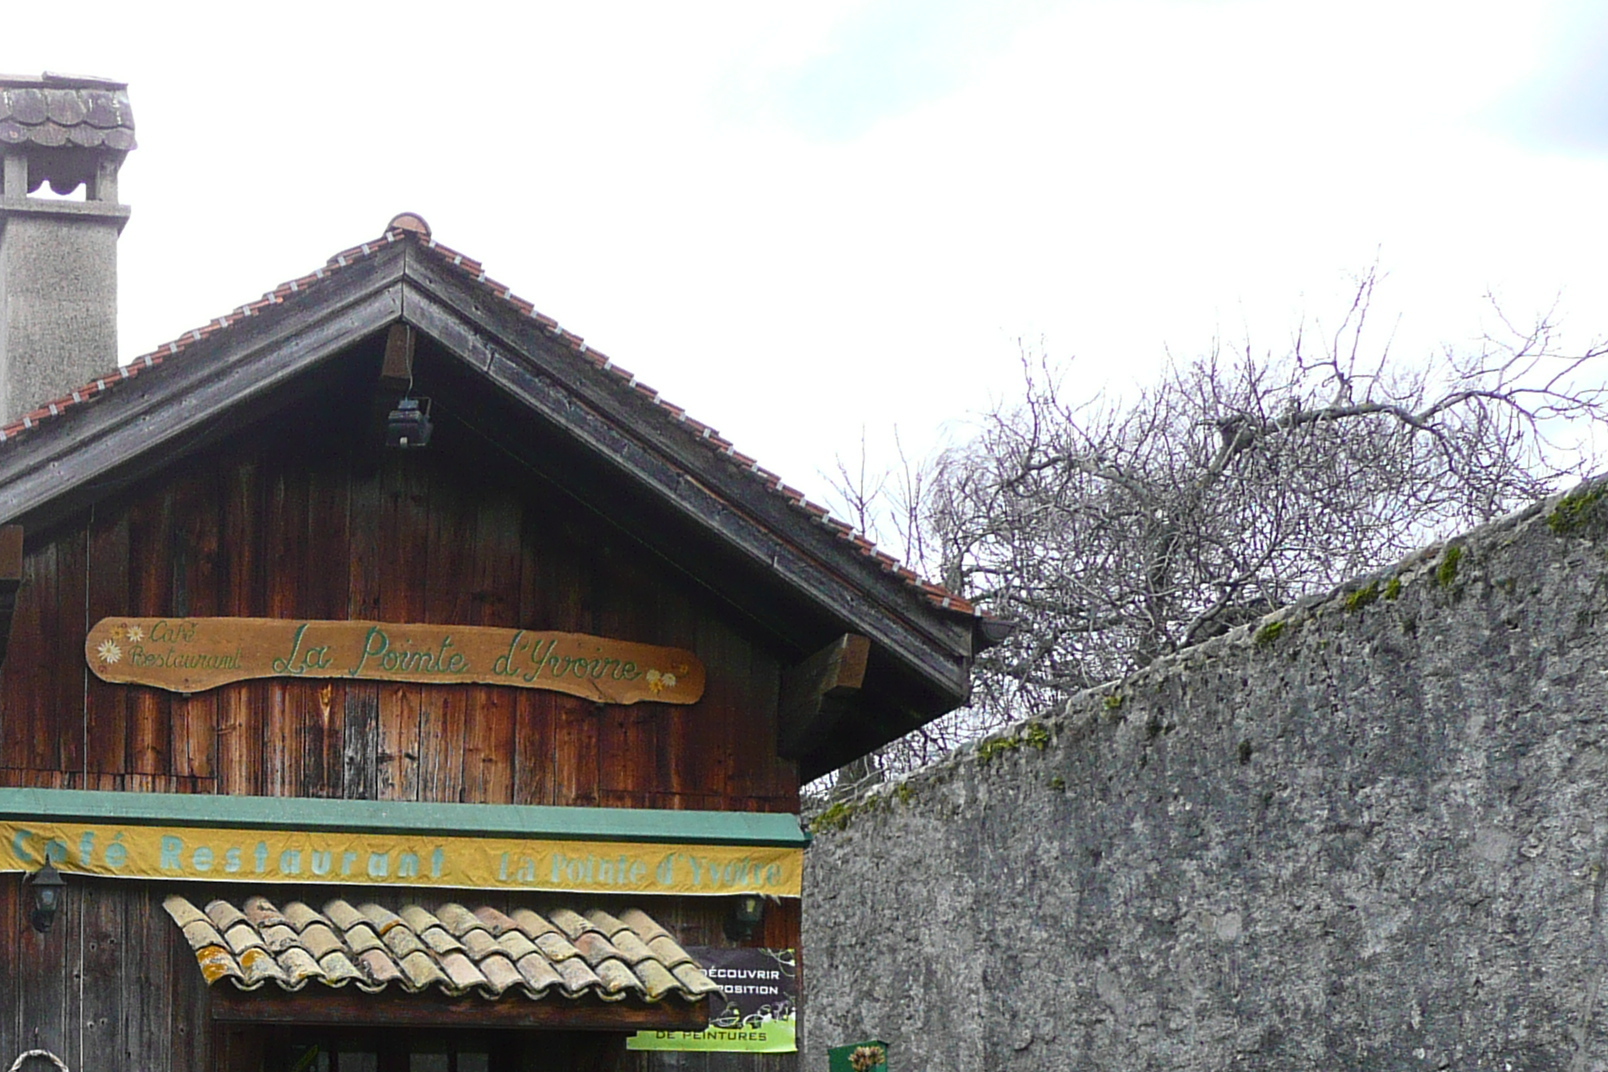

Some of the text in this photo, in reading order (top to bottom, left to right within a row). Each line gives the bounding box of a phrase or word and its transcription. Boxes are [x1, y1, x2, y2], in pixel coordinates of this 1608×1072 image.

[148, 620, 198, 643] Café
[129, 645, 242, 670] Restaurant
[272, 624, 641, 682] La Pointe d'Yvoire
[12, 829, 128, 868] Café
[160, 834, 445, 879] Restaurant
[497, 851, 535, 882] La
[551, 853, 646, 885] Pointe
[655, 1030, 767, 1042] DE PEINTURES
